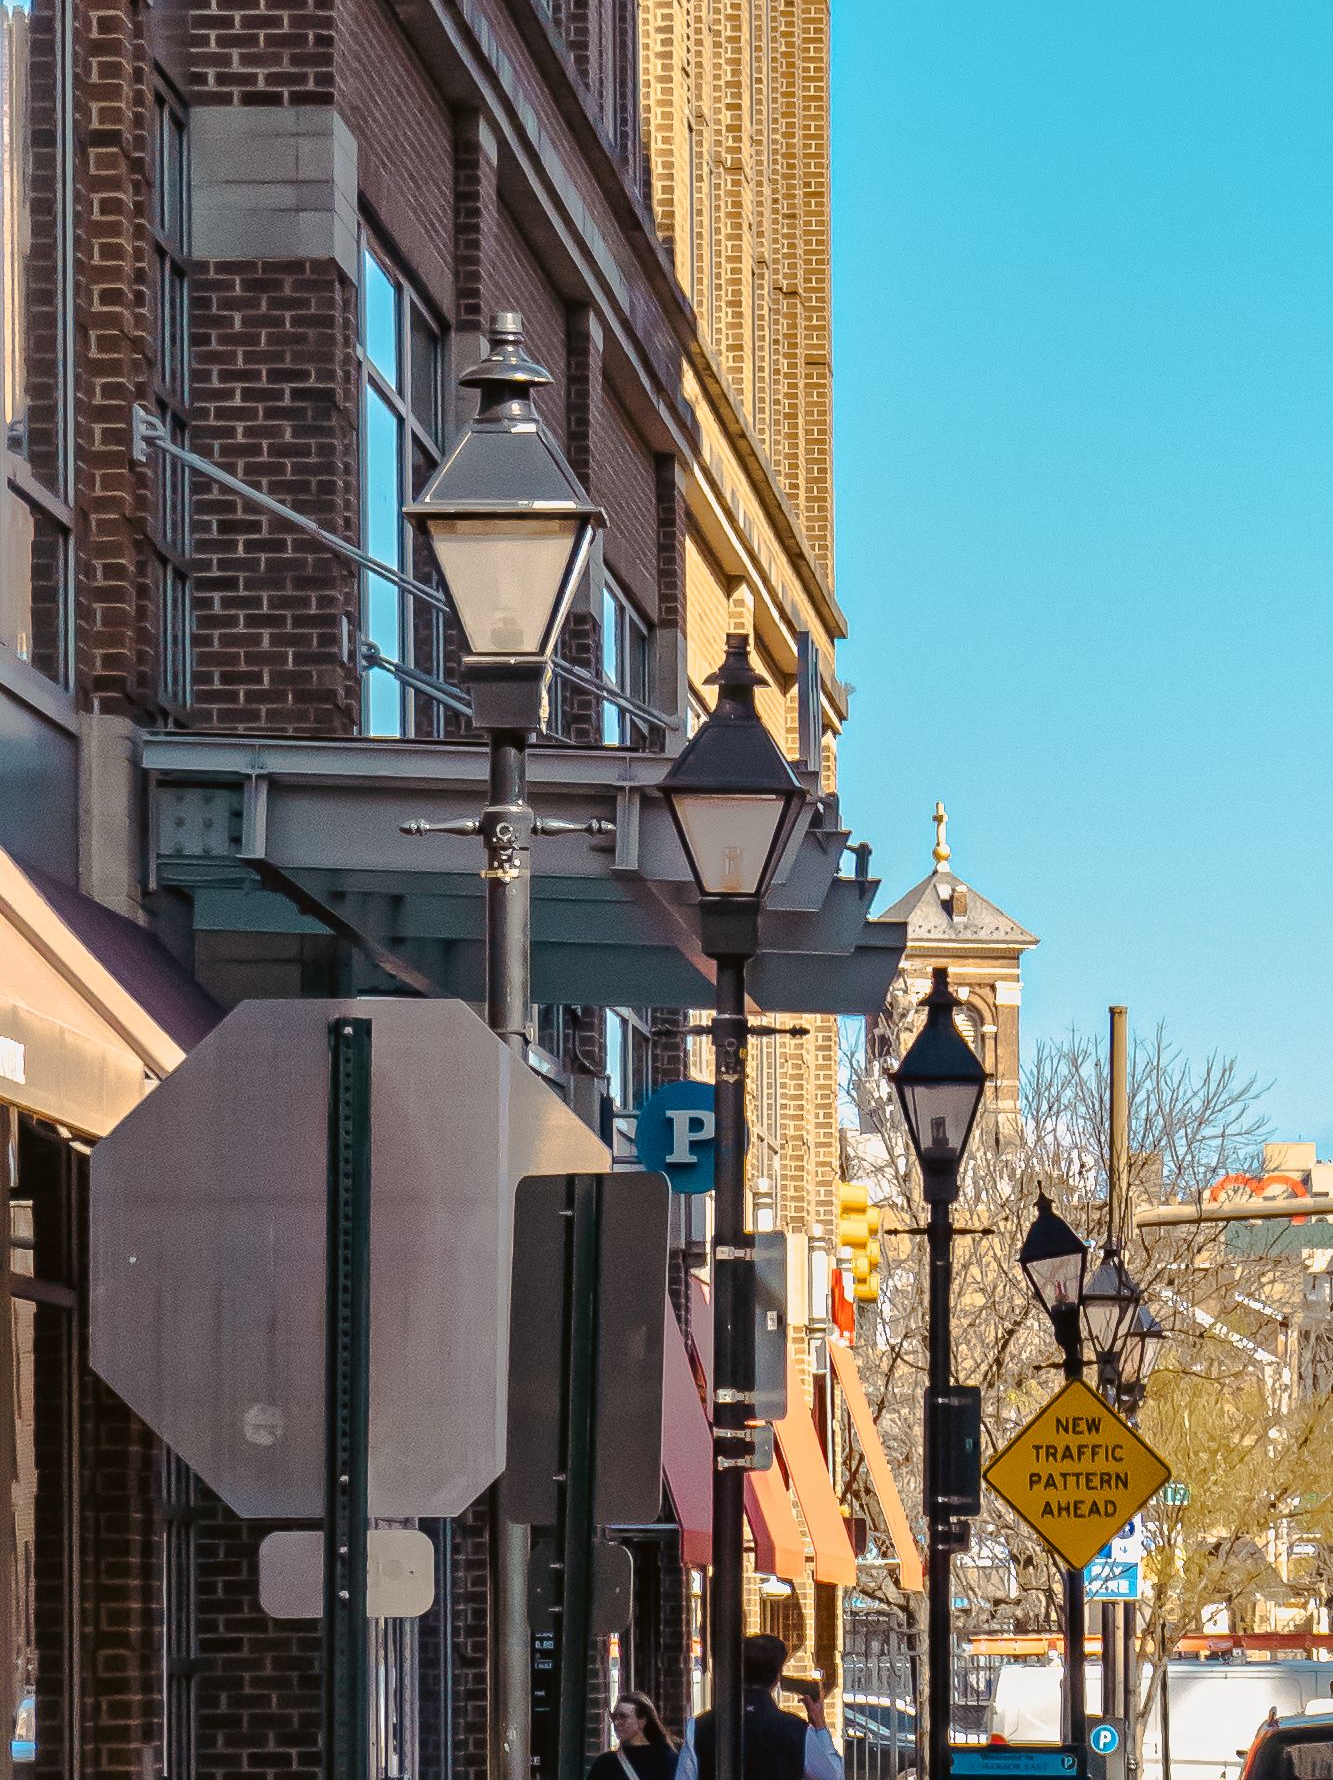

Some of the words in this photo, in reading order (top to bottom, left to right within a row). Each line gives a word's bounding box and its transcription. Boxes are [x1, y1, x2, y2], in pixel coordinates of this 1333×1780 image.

[665, 1109, 716, 1163] P
[1055, 1416, 1102, 1435] NEW
[1032, 1444, 1125, 1463] TRAFFIC
[1028, 1471, 1129, 1491] PATTERN
[1040, 1499, 1118, 1519] AHEAD
[1099, 1729, 1112, 1750] P
